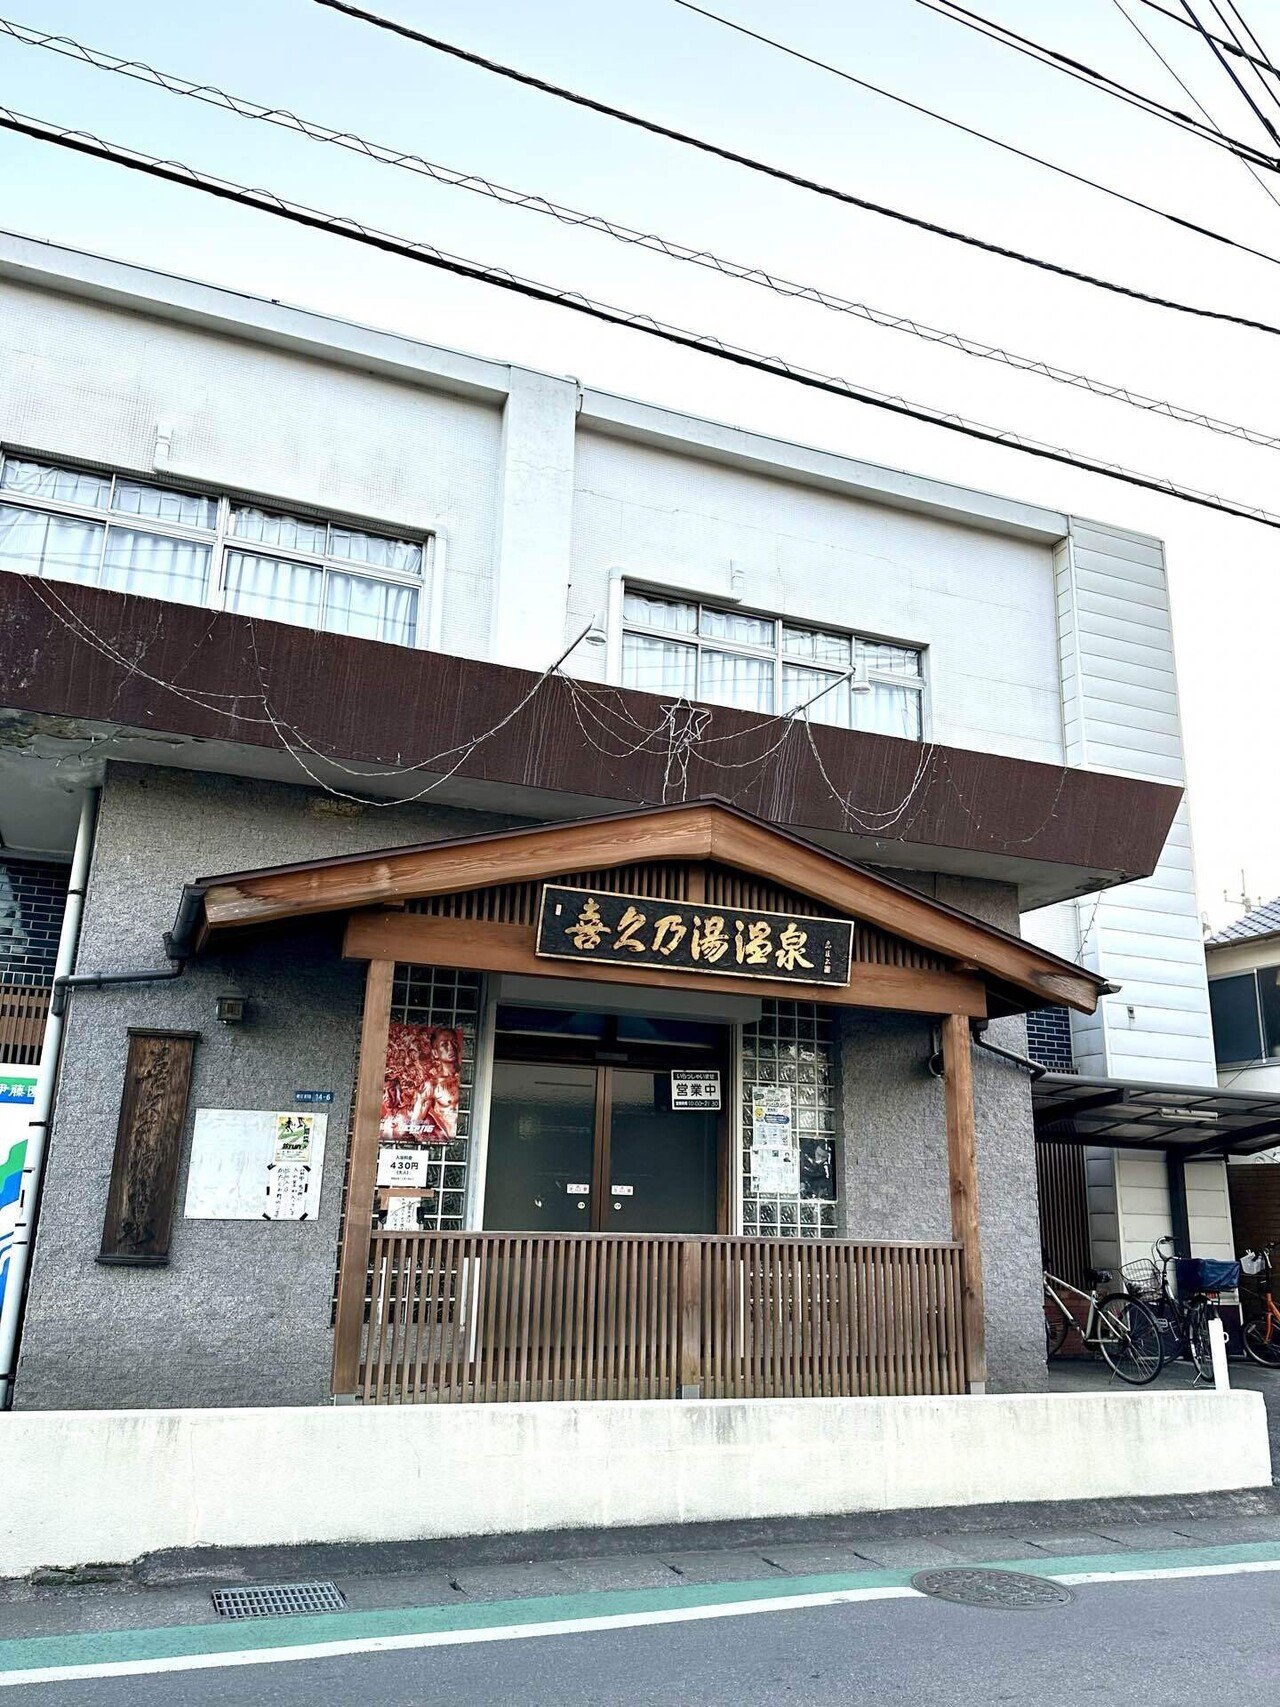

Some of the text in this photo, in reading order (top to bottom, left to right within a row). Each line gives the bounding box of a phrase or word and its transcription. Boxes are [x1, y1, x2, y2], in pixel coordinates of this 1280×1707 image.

[564, 897, 815, 971] 喜久乃湯温泉
[676, 1072, 716, 1080] いらっしゃいませ
[676, 1082, 717, 1097] 営業中
[390, 1161, 419, 1170] 430円
